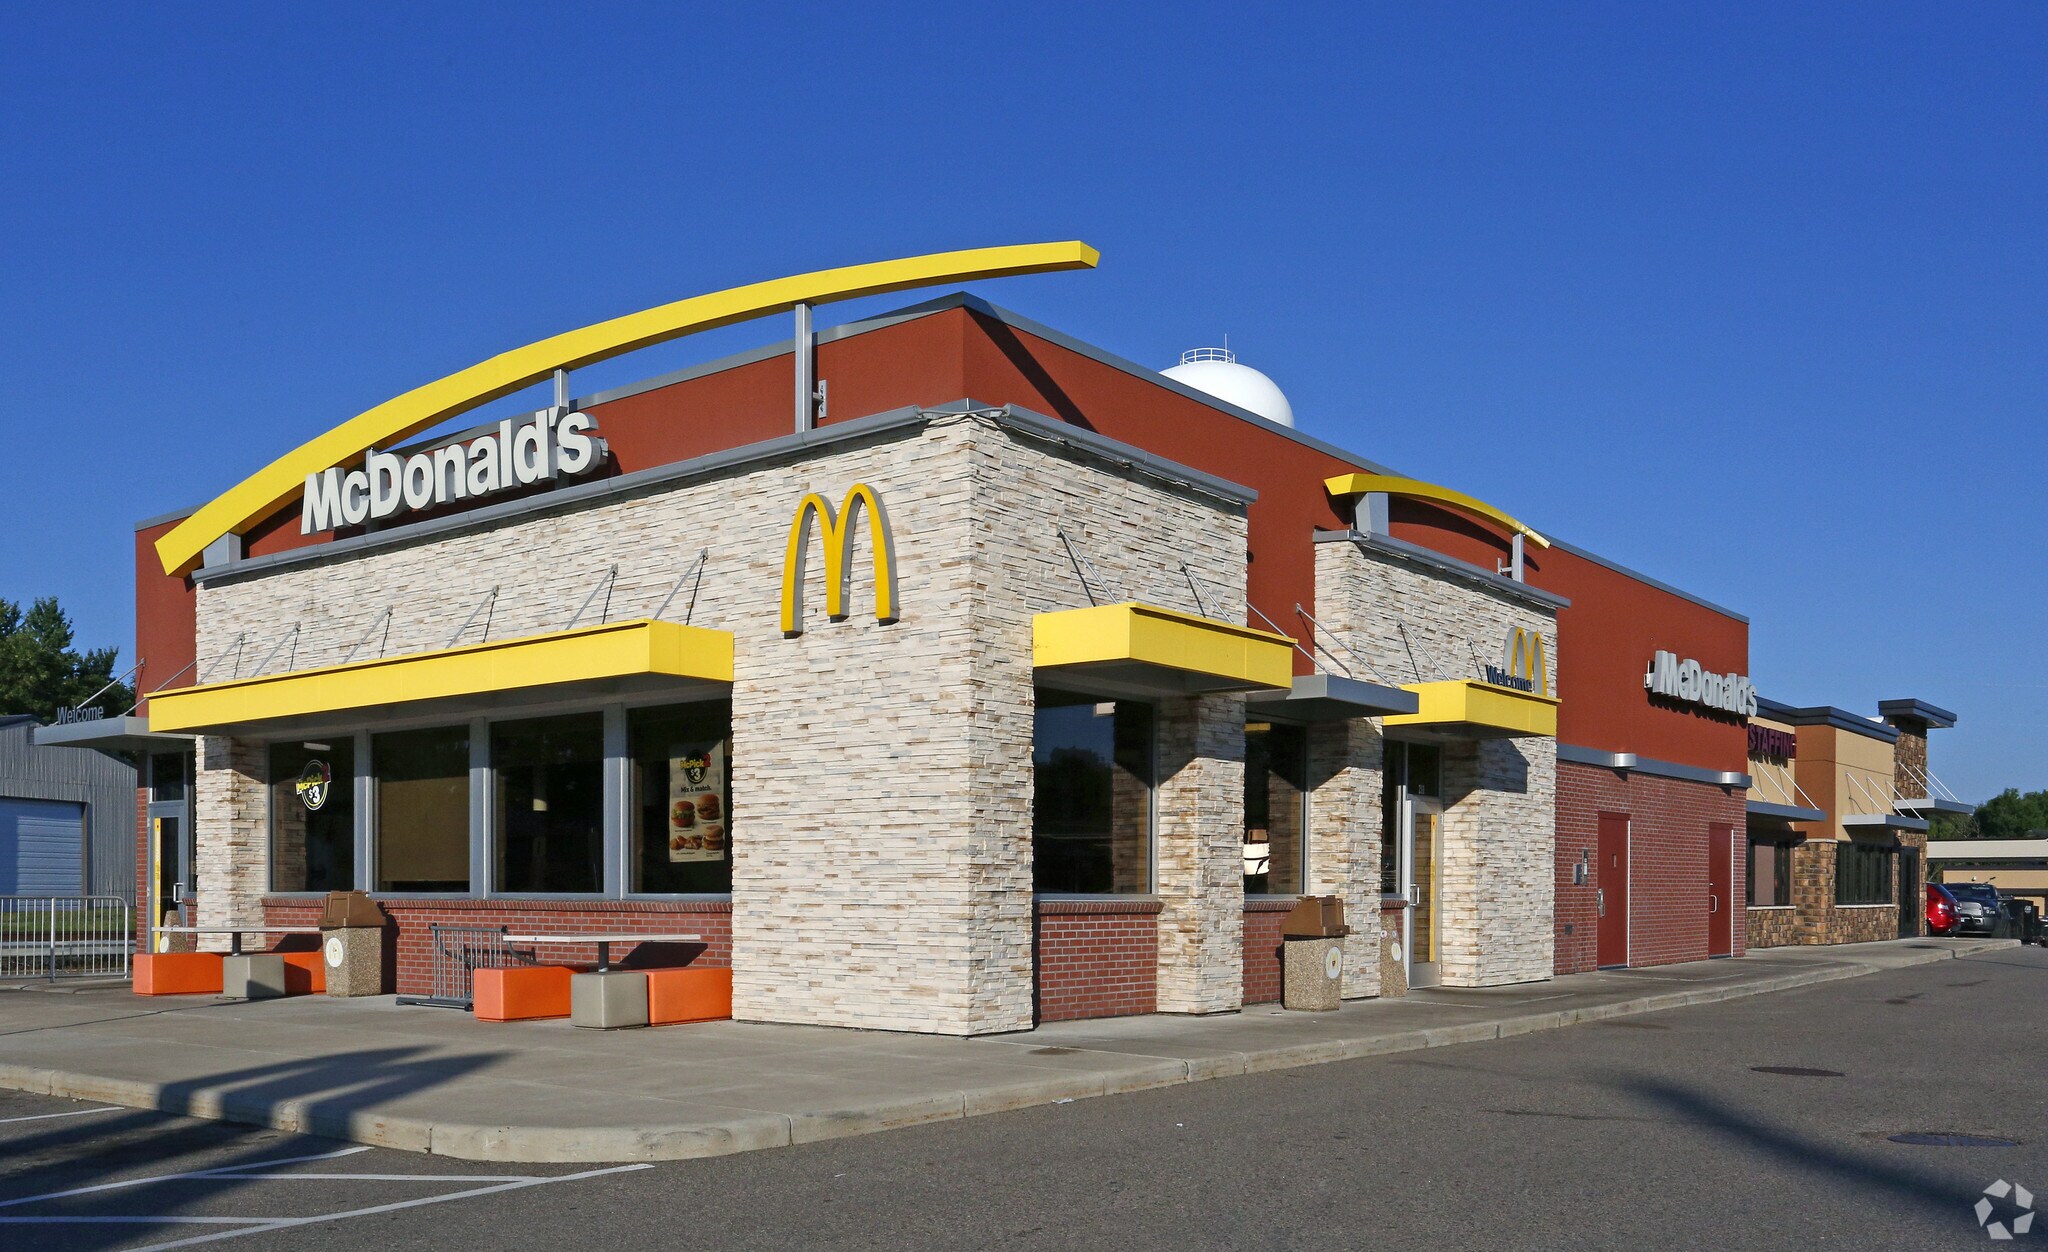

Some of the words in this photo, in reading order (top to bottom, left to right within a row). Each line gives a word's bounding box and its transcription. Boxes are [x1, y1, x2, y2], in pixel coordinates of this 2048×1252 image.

[301, 405, 597, 535] McDonald's
[1485, 665, 1533, 692] Welcome
[57, 705, 104, 725] Welcome
[1748, 723, 1796, 759] STAFFING
[309, 786, 320, 803] $3
